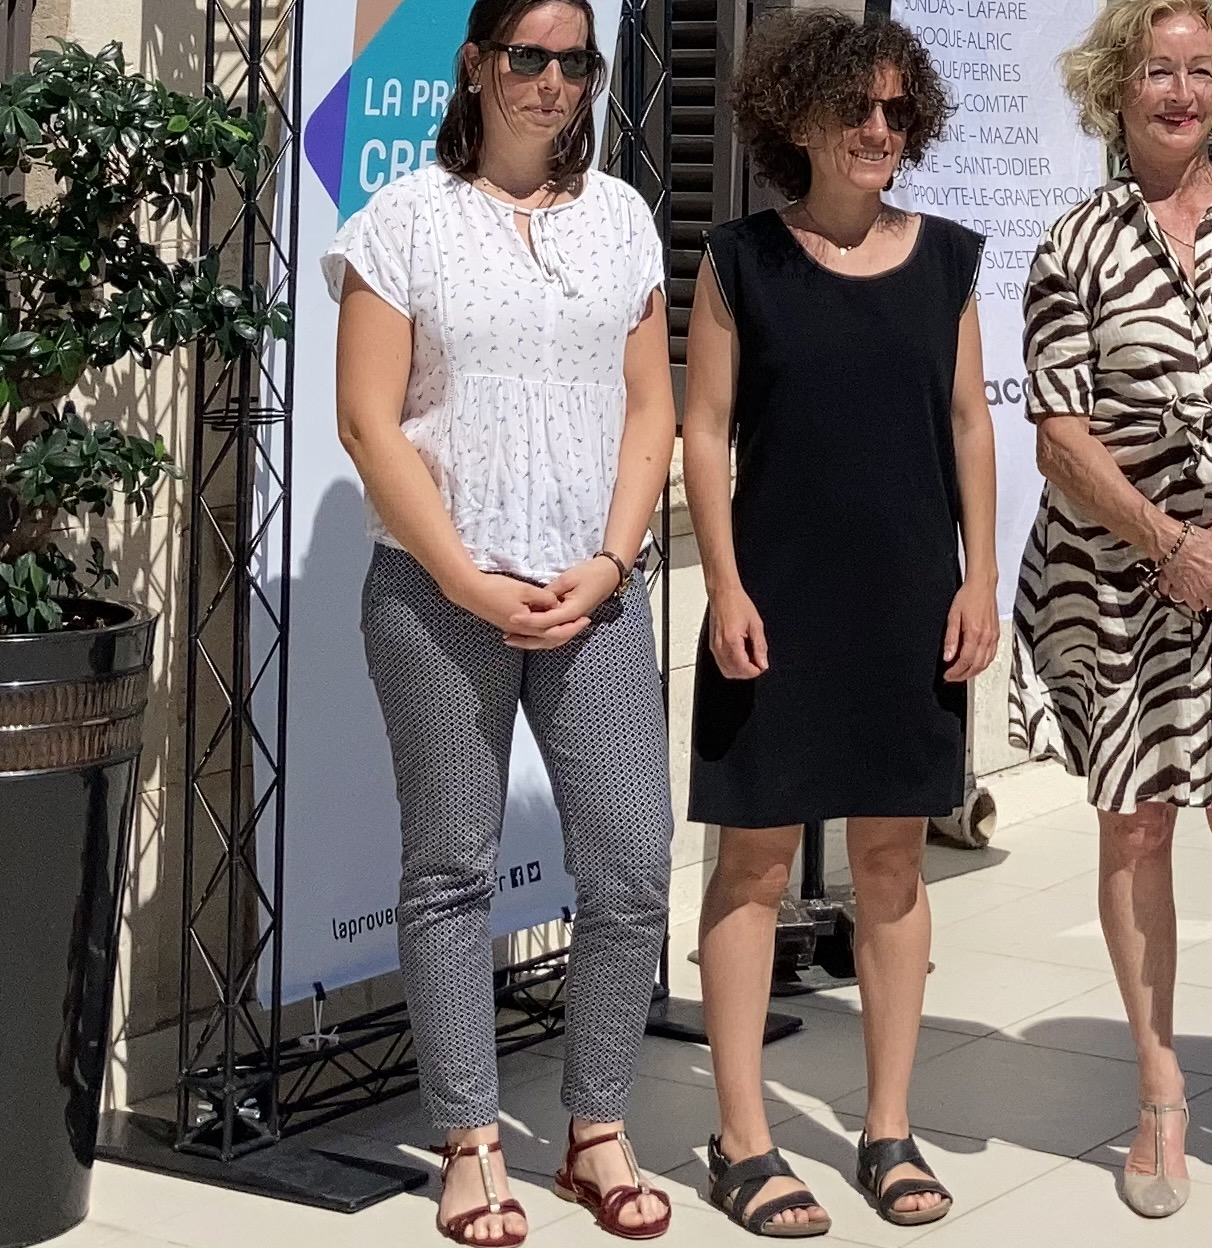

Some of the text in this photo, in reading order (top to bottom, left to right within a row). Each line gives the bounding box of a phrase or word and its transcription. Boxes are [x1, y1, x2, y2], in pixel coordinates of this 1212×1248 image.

[967, 0, 1027, 20] LAFARE
[364, 77, 457, 118] LA PR
[980, 125, 1039, 145] MAZAN
[360, 123, 438, 193] CRÉ
[954, 154, 1051, 176] SAINT-DIDIER
[984, 250, 1037, 270] SUZET
